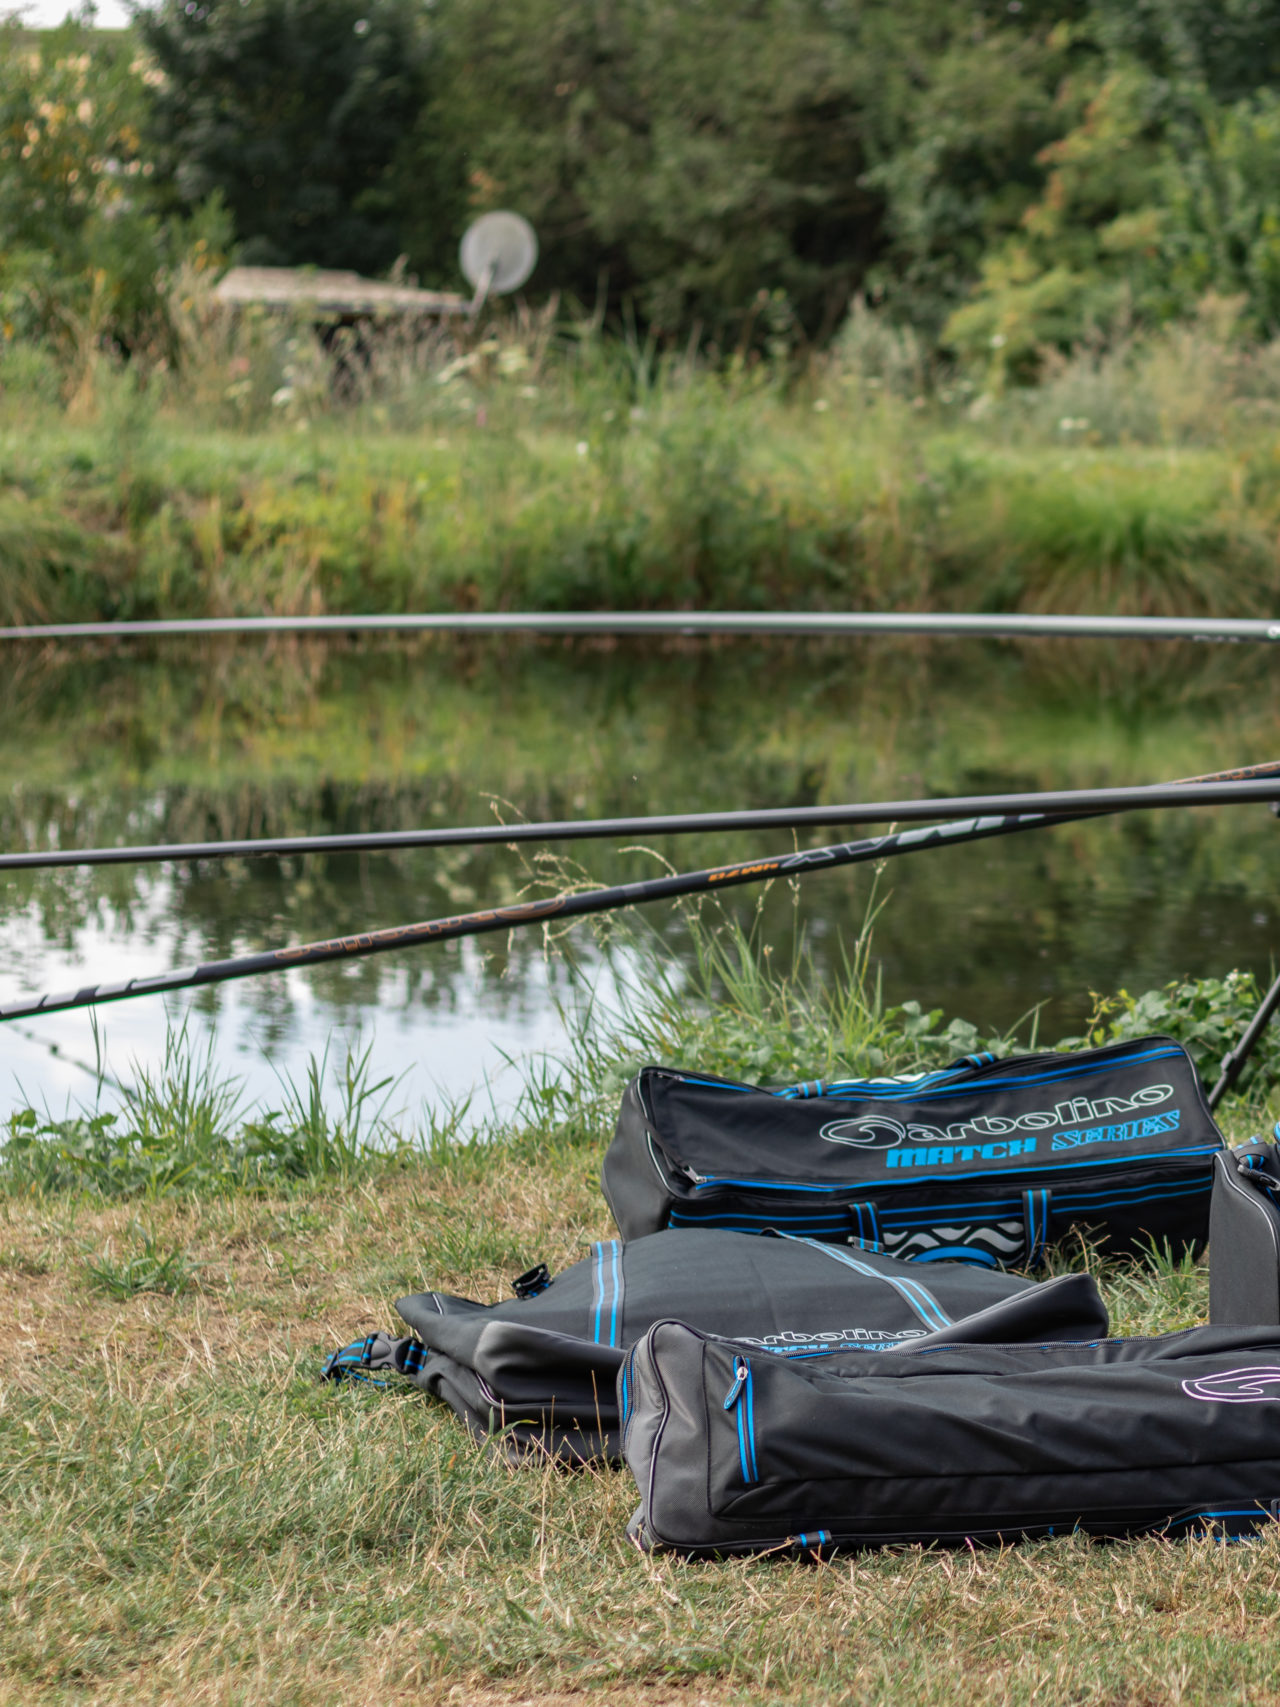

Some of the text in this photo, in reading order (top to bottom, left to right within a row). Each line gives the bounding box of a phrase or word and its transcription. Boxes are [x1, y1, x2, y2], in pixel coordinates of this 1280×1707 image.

[819, 1084, 1174, 1150] Garbolino
[886, 1110, 1181, 1169] MATCH SERIES
[730, 1328, 927, 1346] arbolino
